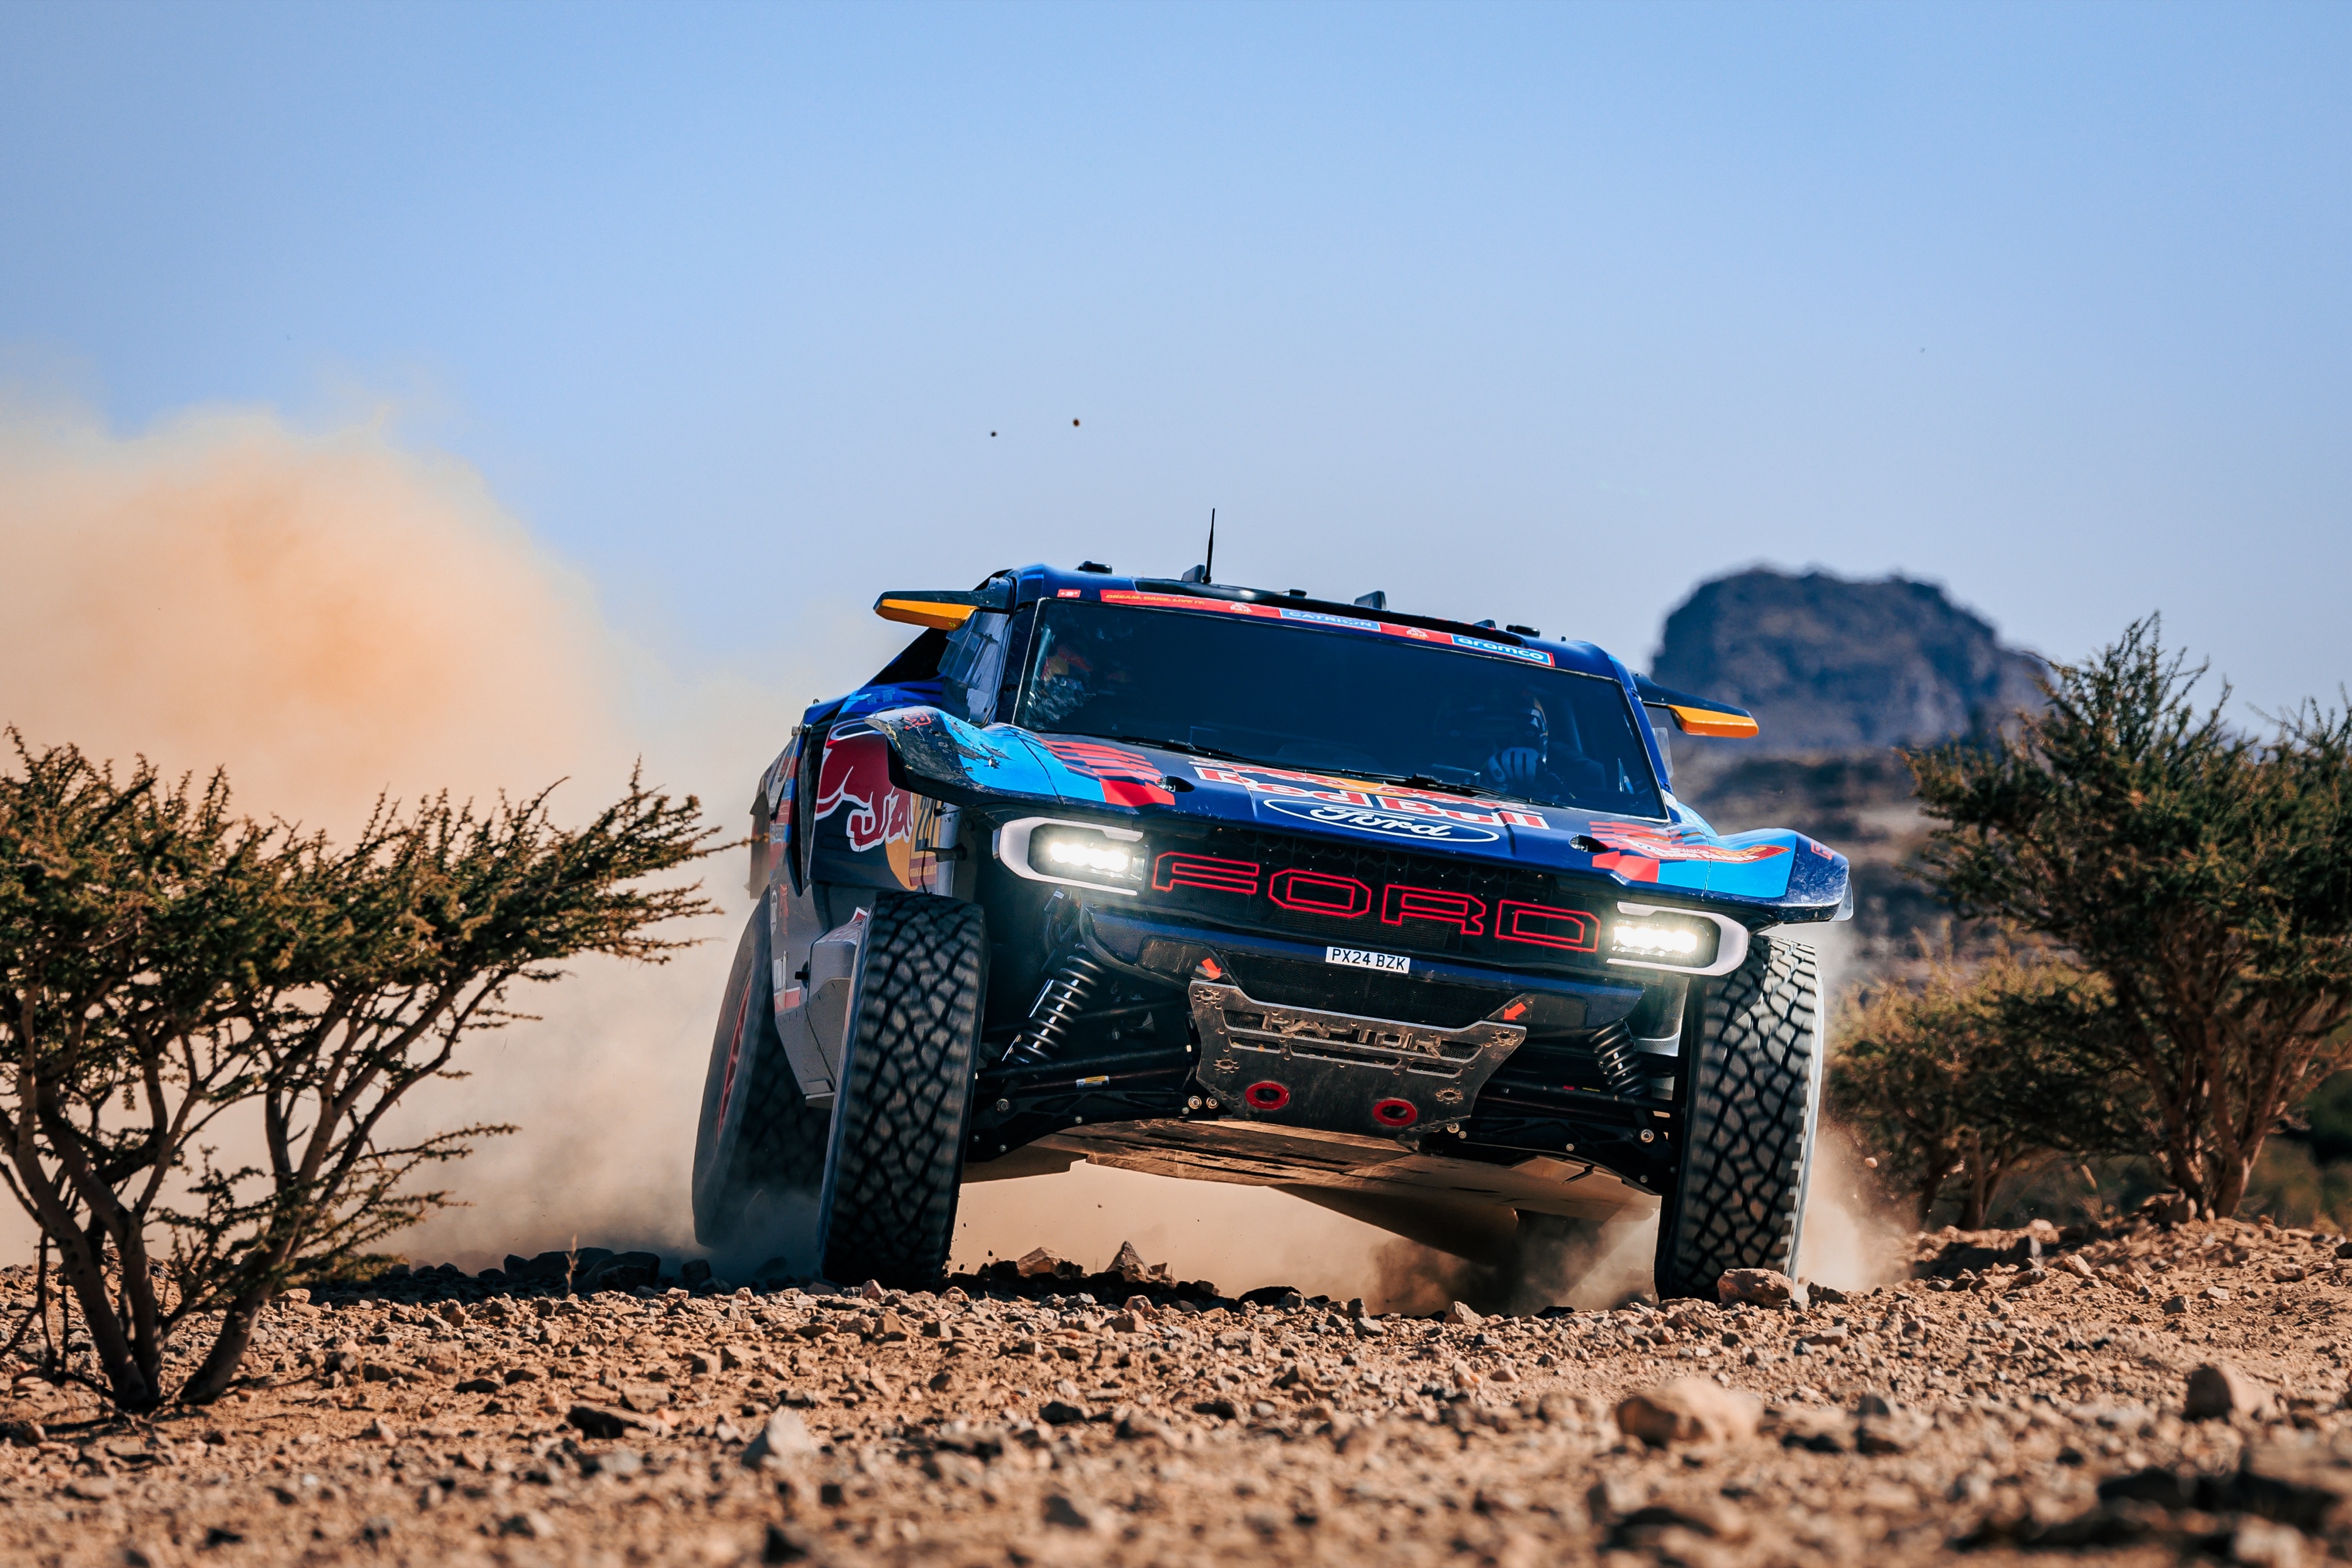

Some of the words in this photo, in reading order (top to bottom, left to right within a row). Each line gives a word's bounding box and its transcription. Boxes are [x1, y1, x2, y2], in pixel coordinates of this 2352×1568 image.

[1457, 638, 1544, 660] aramco
[1193, 766, 1374, 808] Red
[1375, 795, 1551, 830] Bull
[1310, 806, 1453, 837] Ford
[1151, 851, 1601, 953] FORD
[1332, 948, 1371, 966] PX24
[1375, 954, 1406, 971] BZK
[1261, 1010, 1442, 1059] RAPTOR
